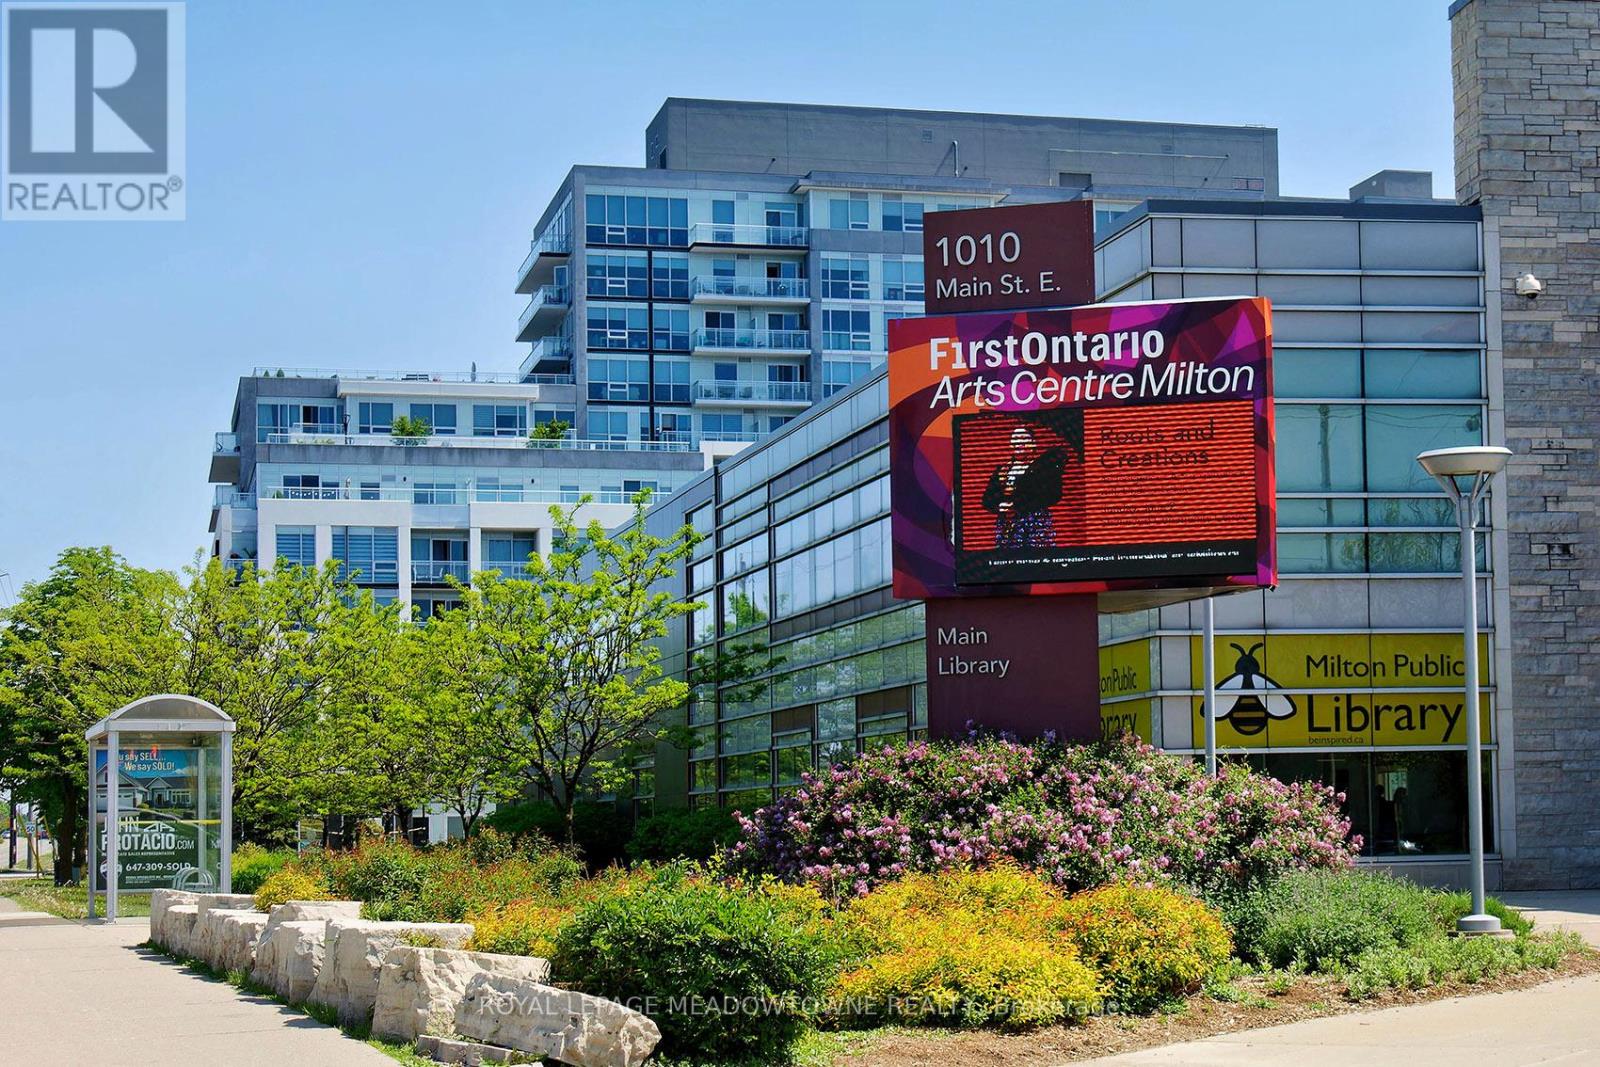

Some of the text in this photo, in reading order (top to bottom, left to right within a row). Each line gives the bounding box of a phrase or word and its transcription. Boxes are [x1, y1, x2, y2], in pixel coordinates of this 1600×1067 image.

[935, 231, 1021, 267] 1010
[936, 271, 1061, 299] Main St. E.
[929, 360, 1255, 409] Arts Centre Milton
[1173, 416, 1215, 441] and
[1101, 447, 1210, 469] Creations
[937, 627, 988, 646] Main
[938, 656, 1010, 678] Library
[1306, 653, 1465, 678] Milton Public
[1113, 665, 1137, 692] Public
[1307, 694, 1464, 743] Library
[1308, 736, 1364, 745] beinspired.ca
[125, 762, 137, 771] We
[138, 763, 151, 772] say
[101, 816, 139, 833] JHN
[101, 833, 195, 851] POTACIO.COM
